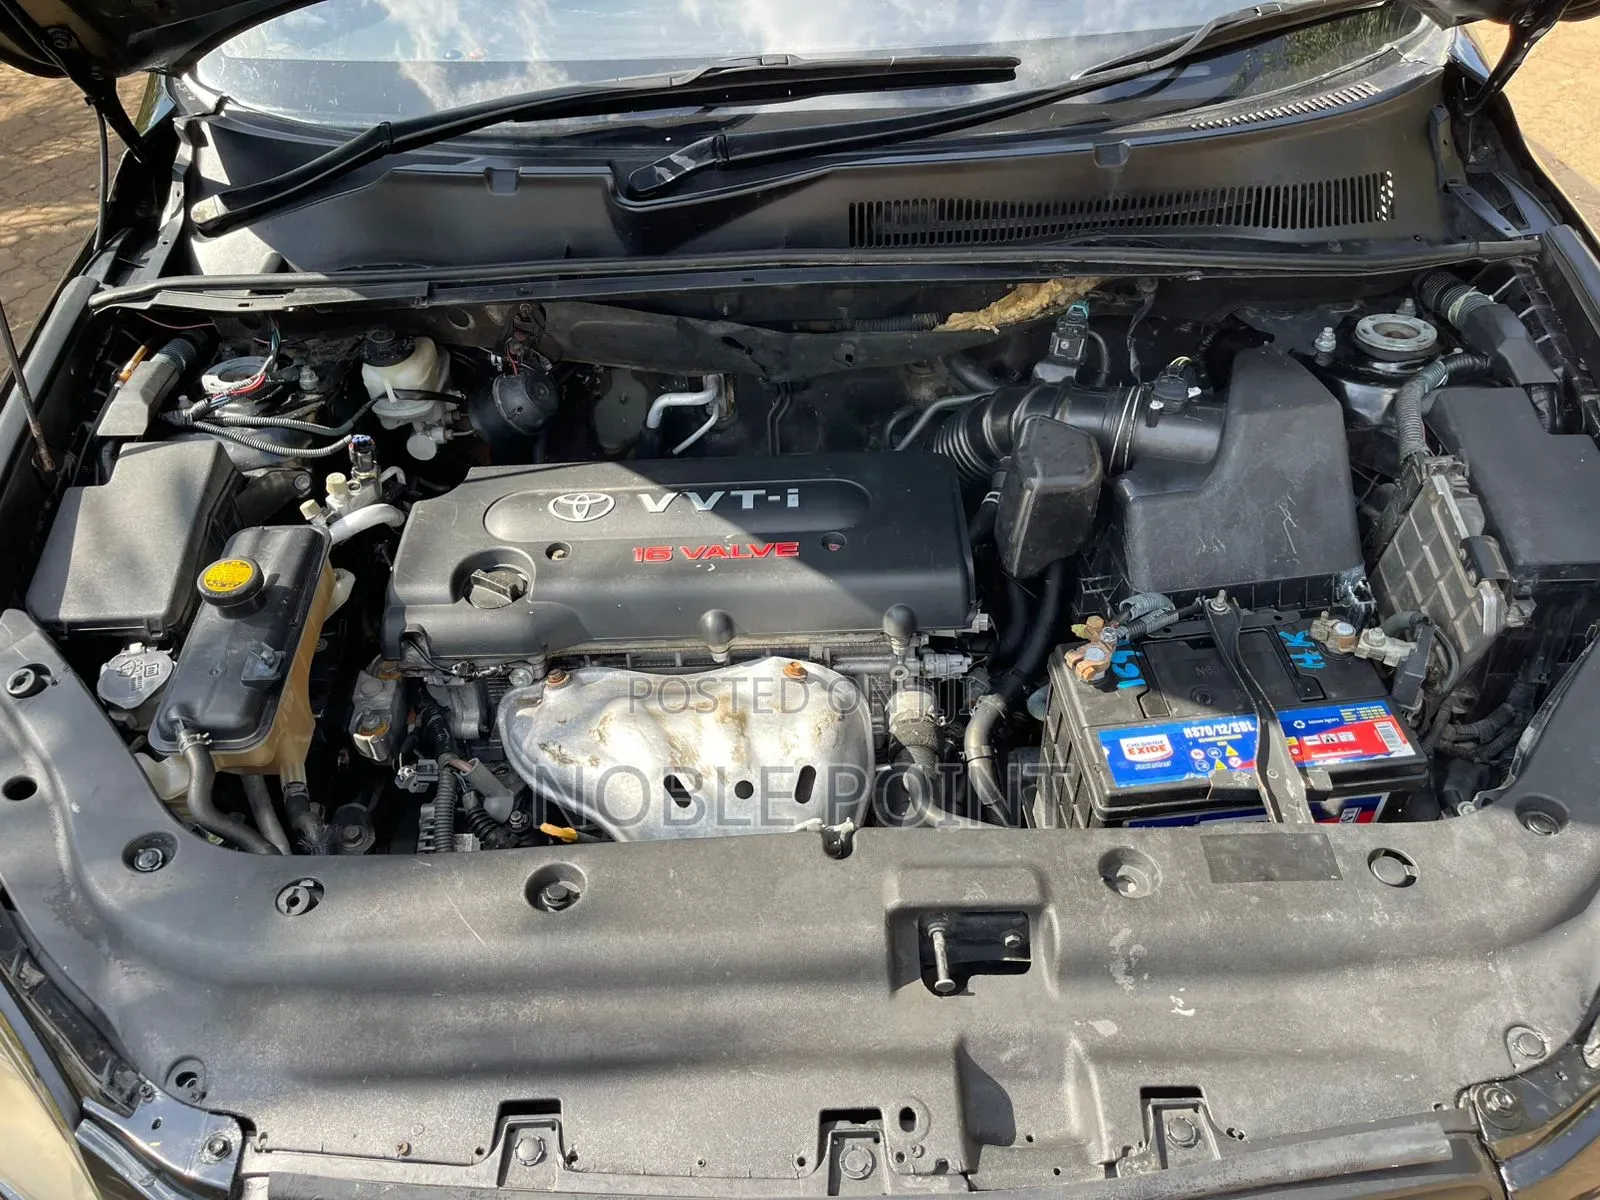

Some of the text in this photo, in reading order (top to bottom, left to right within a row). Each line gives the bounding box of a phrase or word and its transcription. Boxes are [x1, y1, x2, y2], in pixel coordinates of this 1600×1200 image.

[637, 488, 799, 513] VVT-i
[633, 541, 800, 562] 16 VALVE
[1128, 744, 1167, 755] EXIDE
